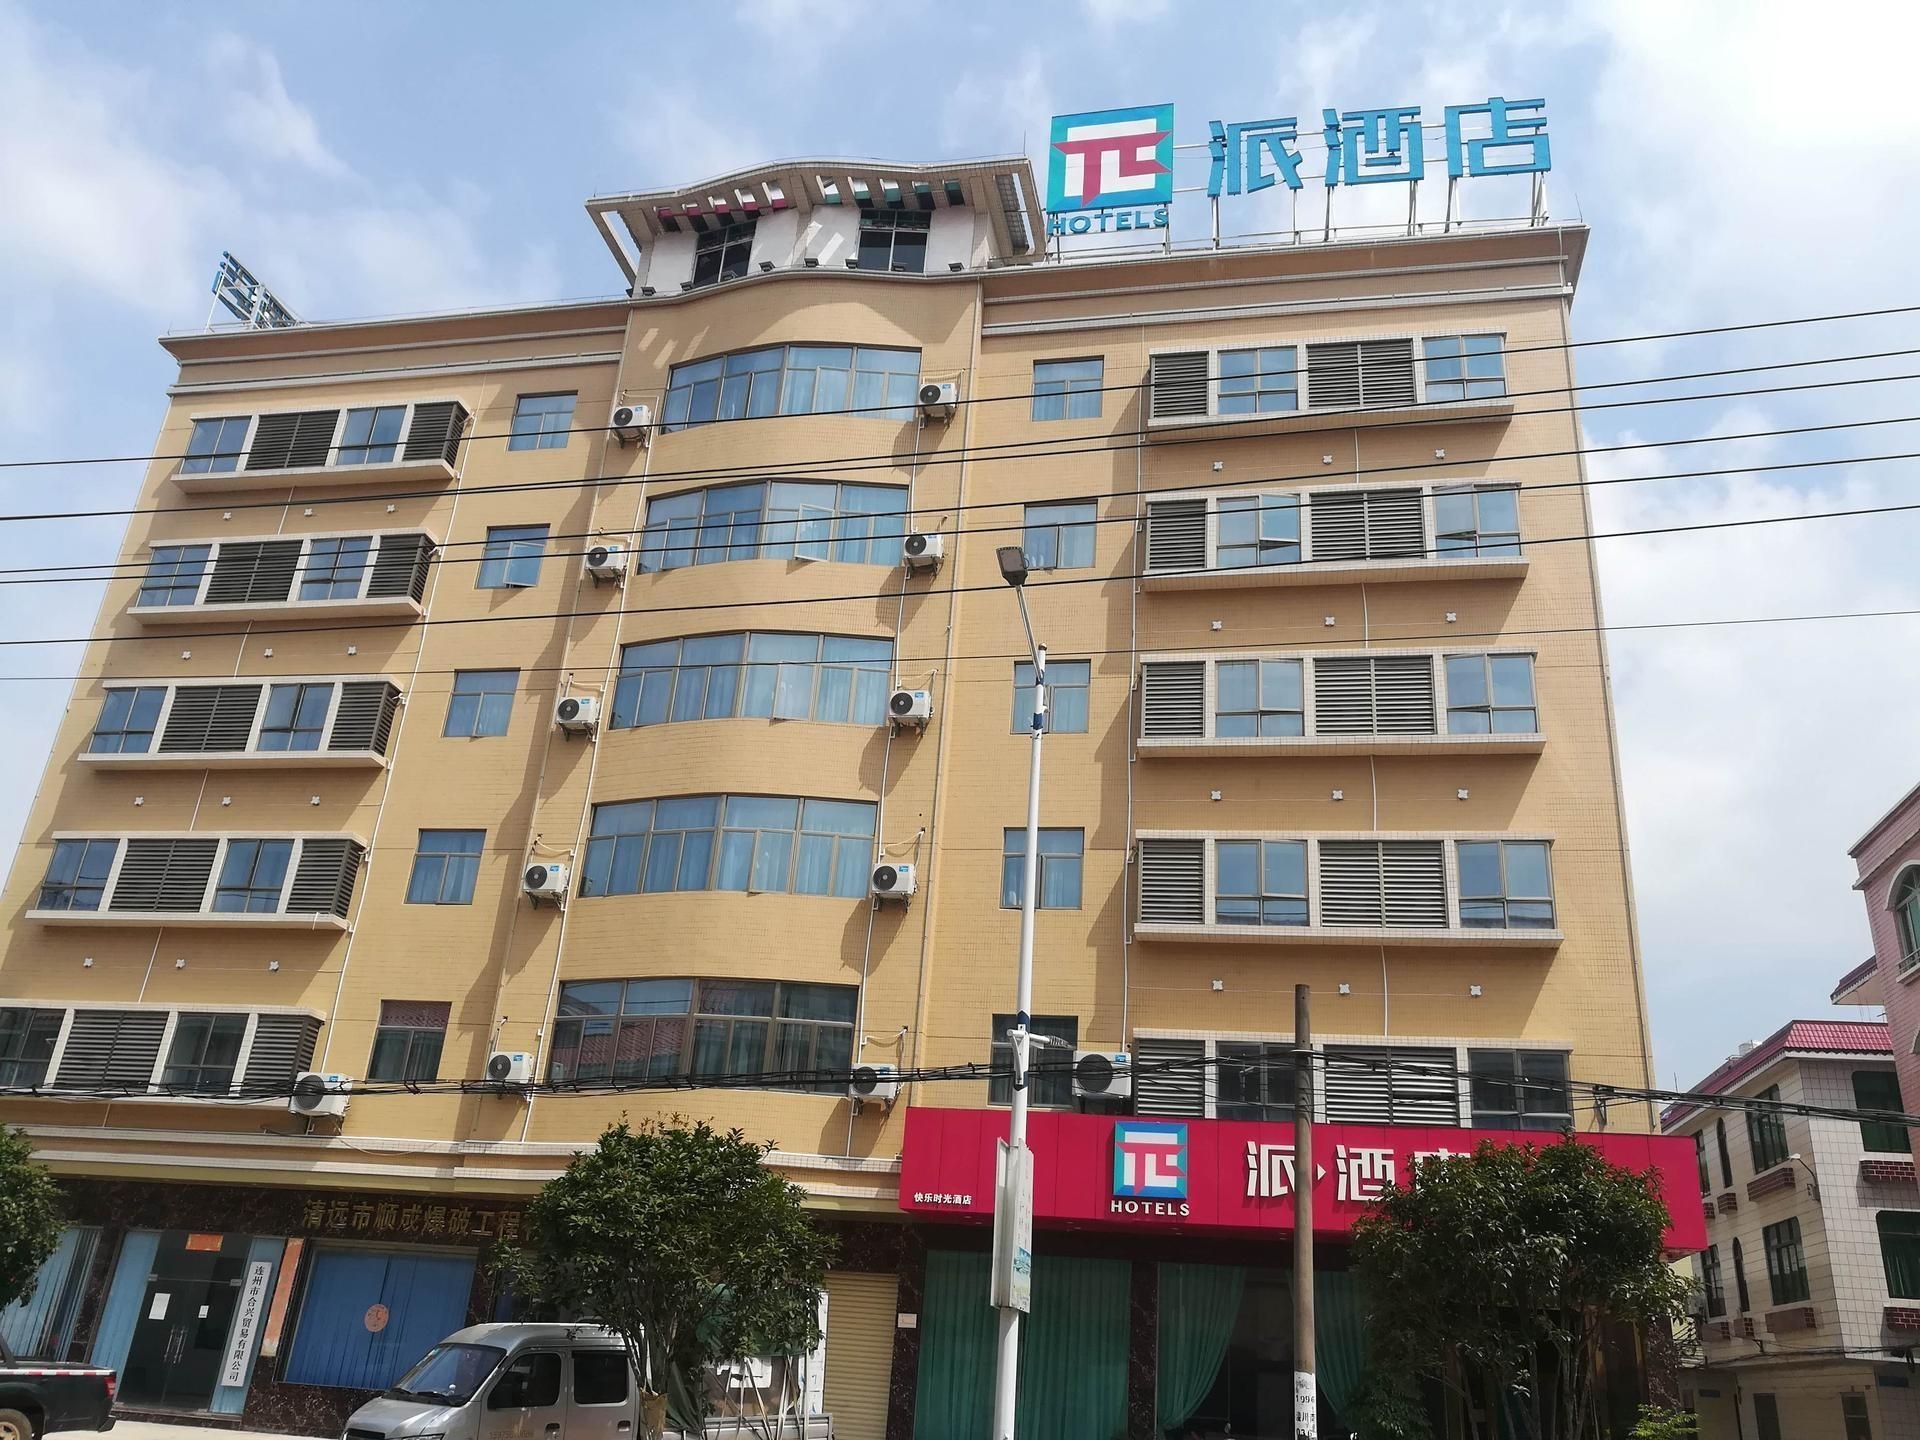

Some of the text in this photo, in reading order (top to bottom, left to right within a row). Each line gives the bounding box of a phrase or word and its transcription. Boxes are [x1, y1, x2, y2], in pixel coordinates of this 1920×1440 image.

[1207, 97, 1551, 198] 派酒店
[1047, 208, 1169, 236] HOTELS
[1246, 1140, 1471, 1202] 派酒
[302, 1198, 530, 1241] 清远市顺成爆破工程
[914, 1192, 972, 1205] 快乐时光酒店
[1110, 1199, 1190, 1217] HOTELS
[228, 1265, 265, 1382] 连州市合兴贸易有限公司
